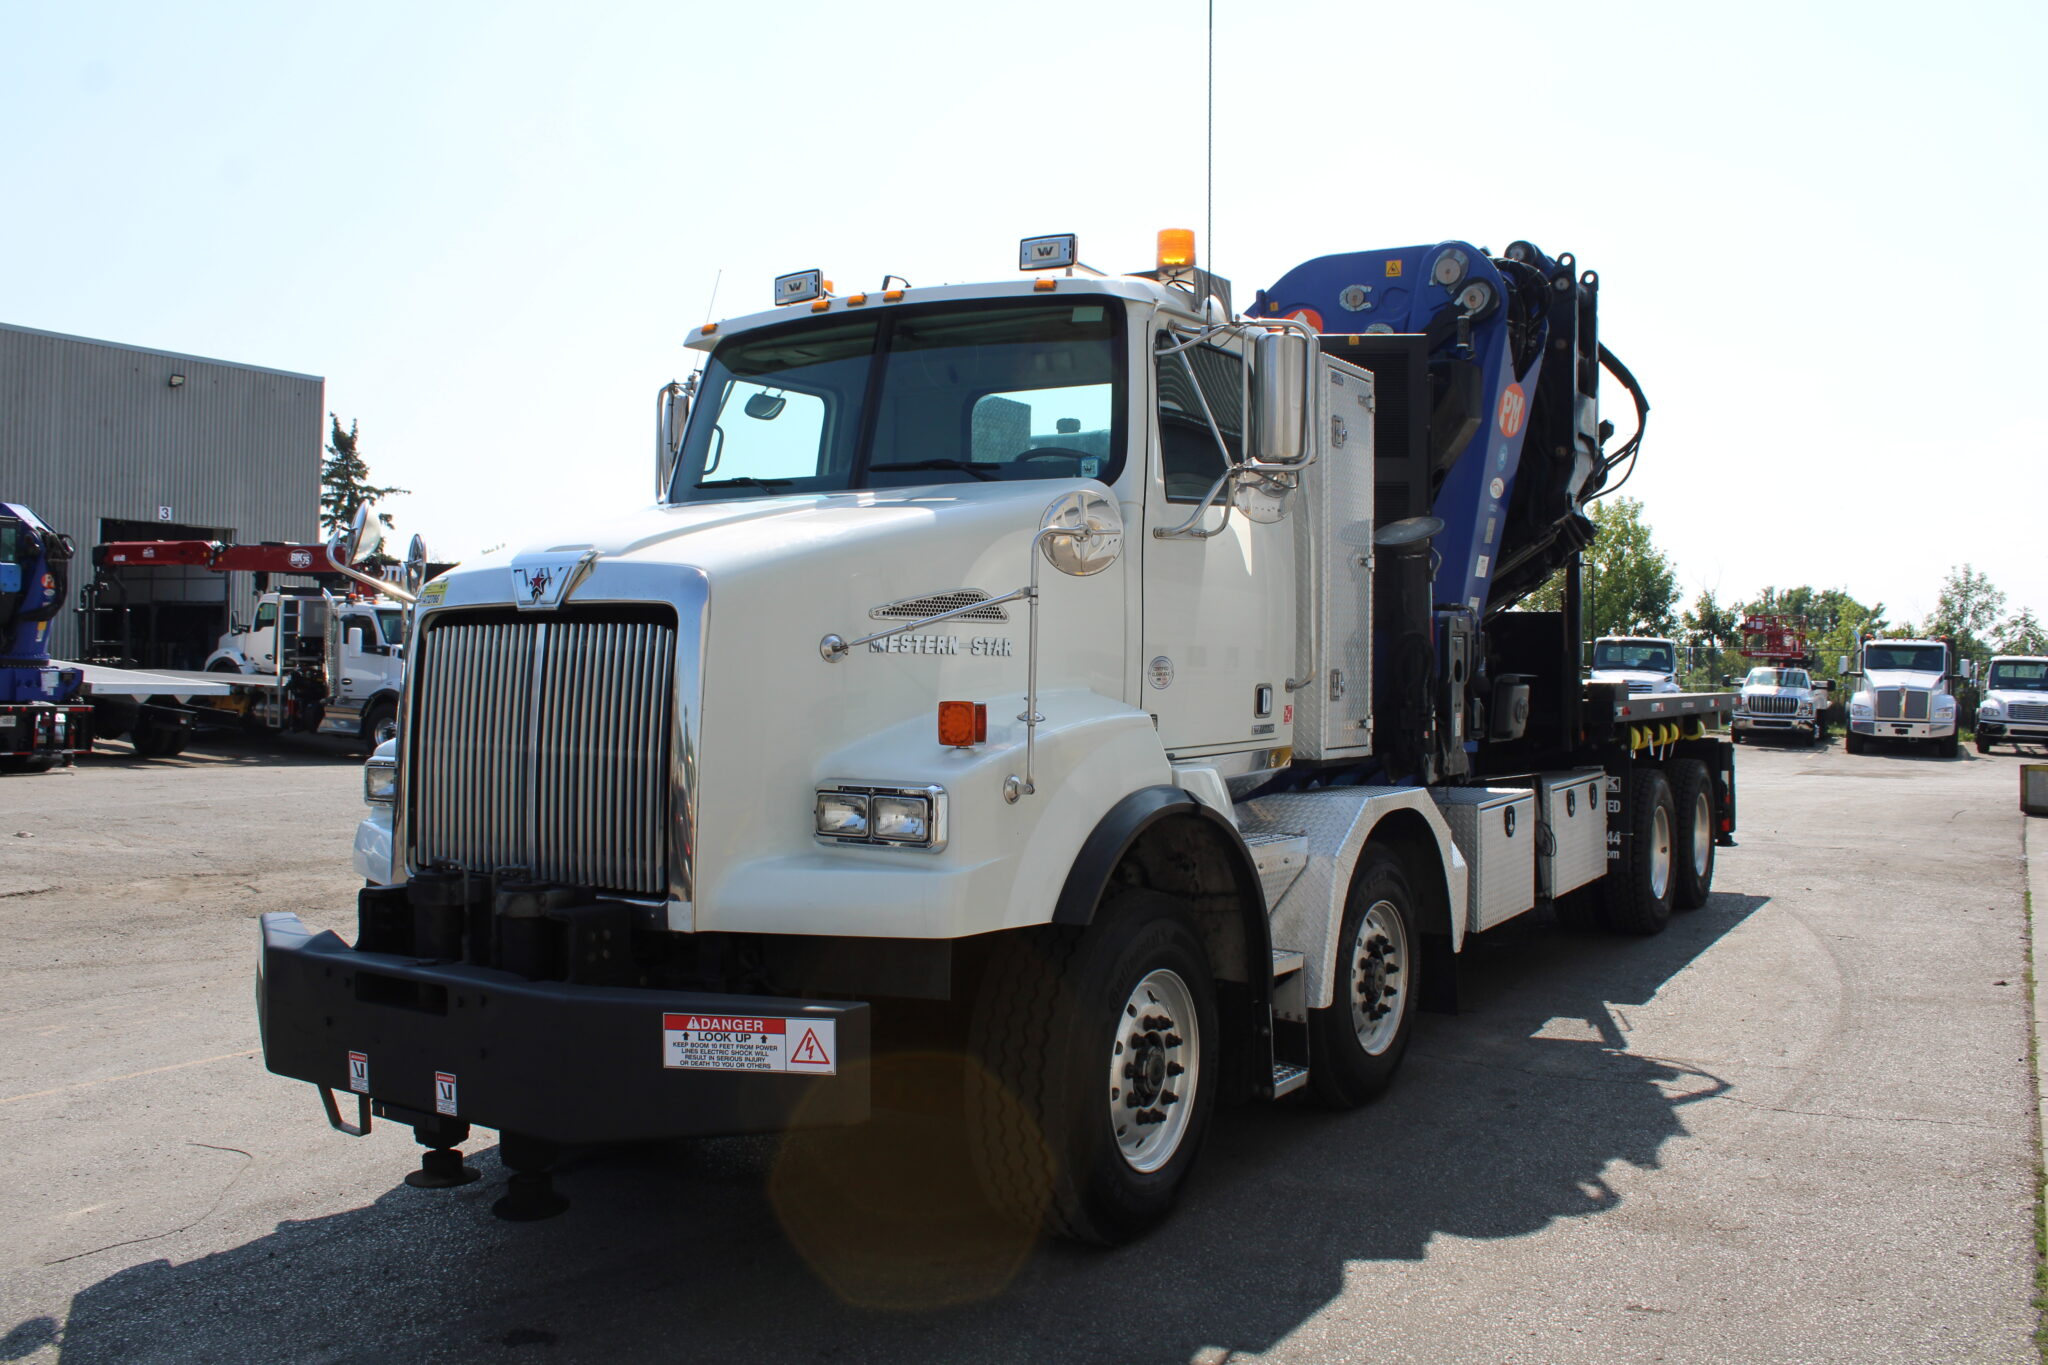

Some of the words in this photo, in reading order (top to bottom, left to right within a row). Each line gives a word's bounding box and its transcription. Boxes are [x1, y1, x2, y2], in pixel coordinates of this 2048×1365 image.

[1499, 389, 1524, 433] PM
[161, 508, 169, 519] 3
[869, 633, 960, 655] WESTERN
[971, 637, 1012, 656] STAR
[701, 1018, 764, 1032] DANGER
[698, 1032, 731, 1042] LOOK
[736, 1033, 751, 1043] UP
